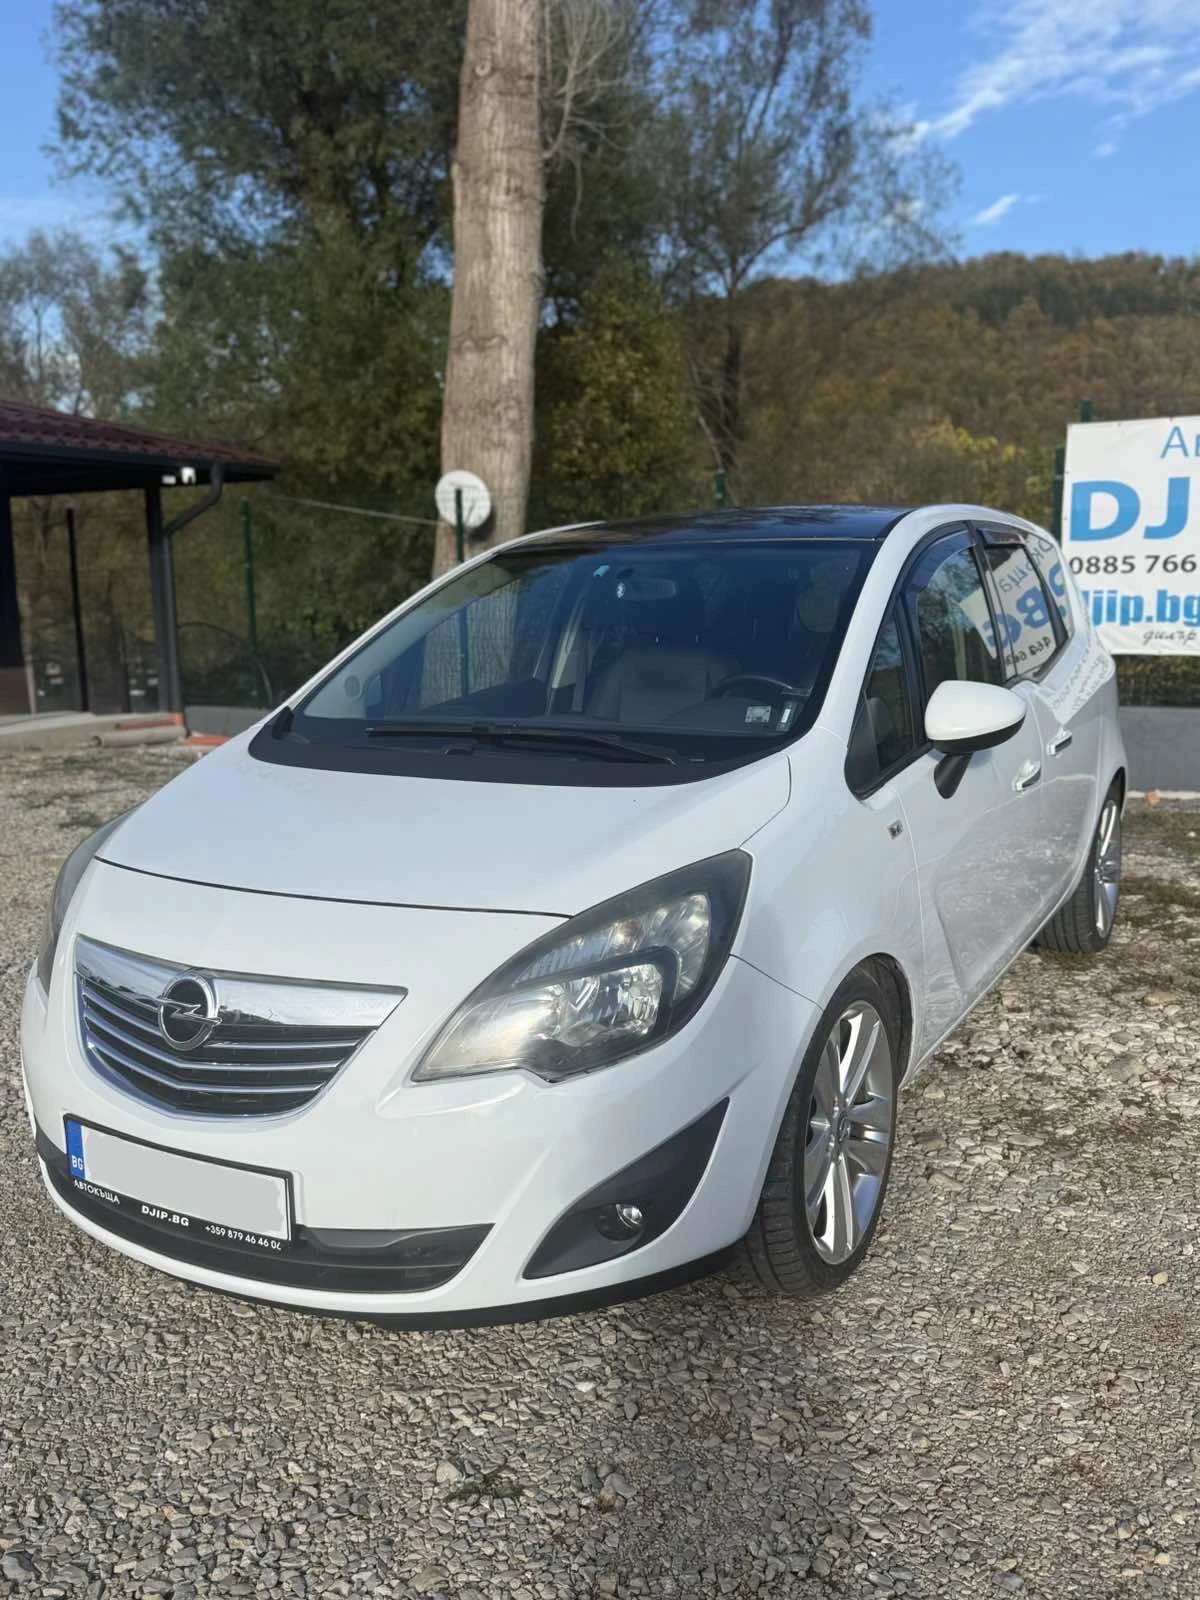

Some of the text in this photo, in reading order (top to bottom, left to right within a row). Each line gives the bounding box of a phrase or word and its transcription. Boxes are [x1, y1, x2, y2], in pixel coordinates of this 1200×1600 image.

[1068, 554, 1197, 575] 0885 766
[1080, 589, 1200, 628] jip.bg
[71, 1155, 84, 1170] BG
[73, 1179, 121, 1205] АВТОКЪЩА
[141, 1204, 190, 1227] DJIP.BG
[205, 1224, 226, 1237] +359
[227, 1230, 244, 1241] 879
[245, 1234, 257, 1244] 46
[258, 1237, 269, 1247] 46
